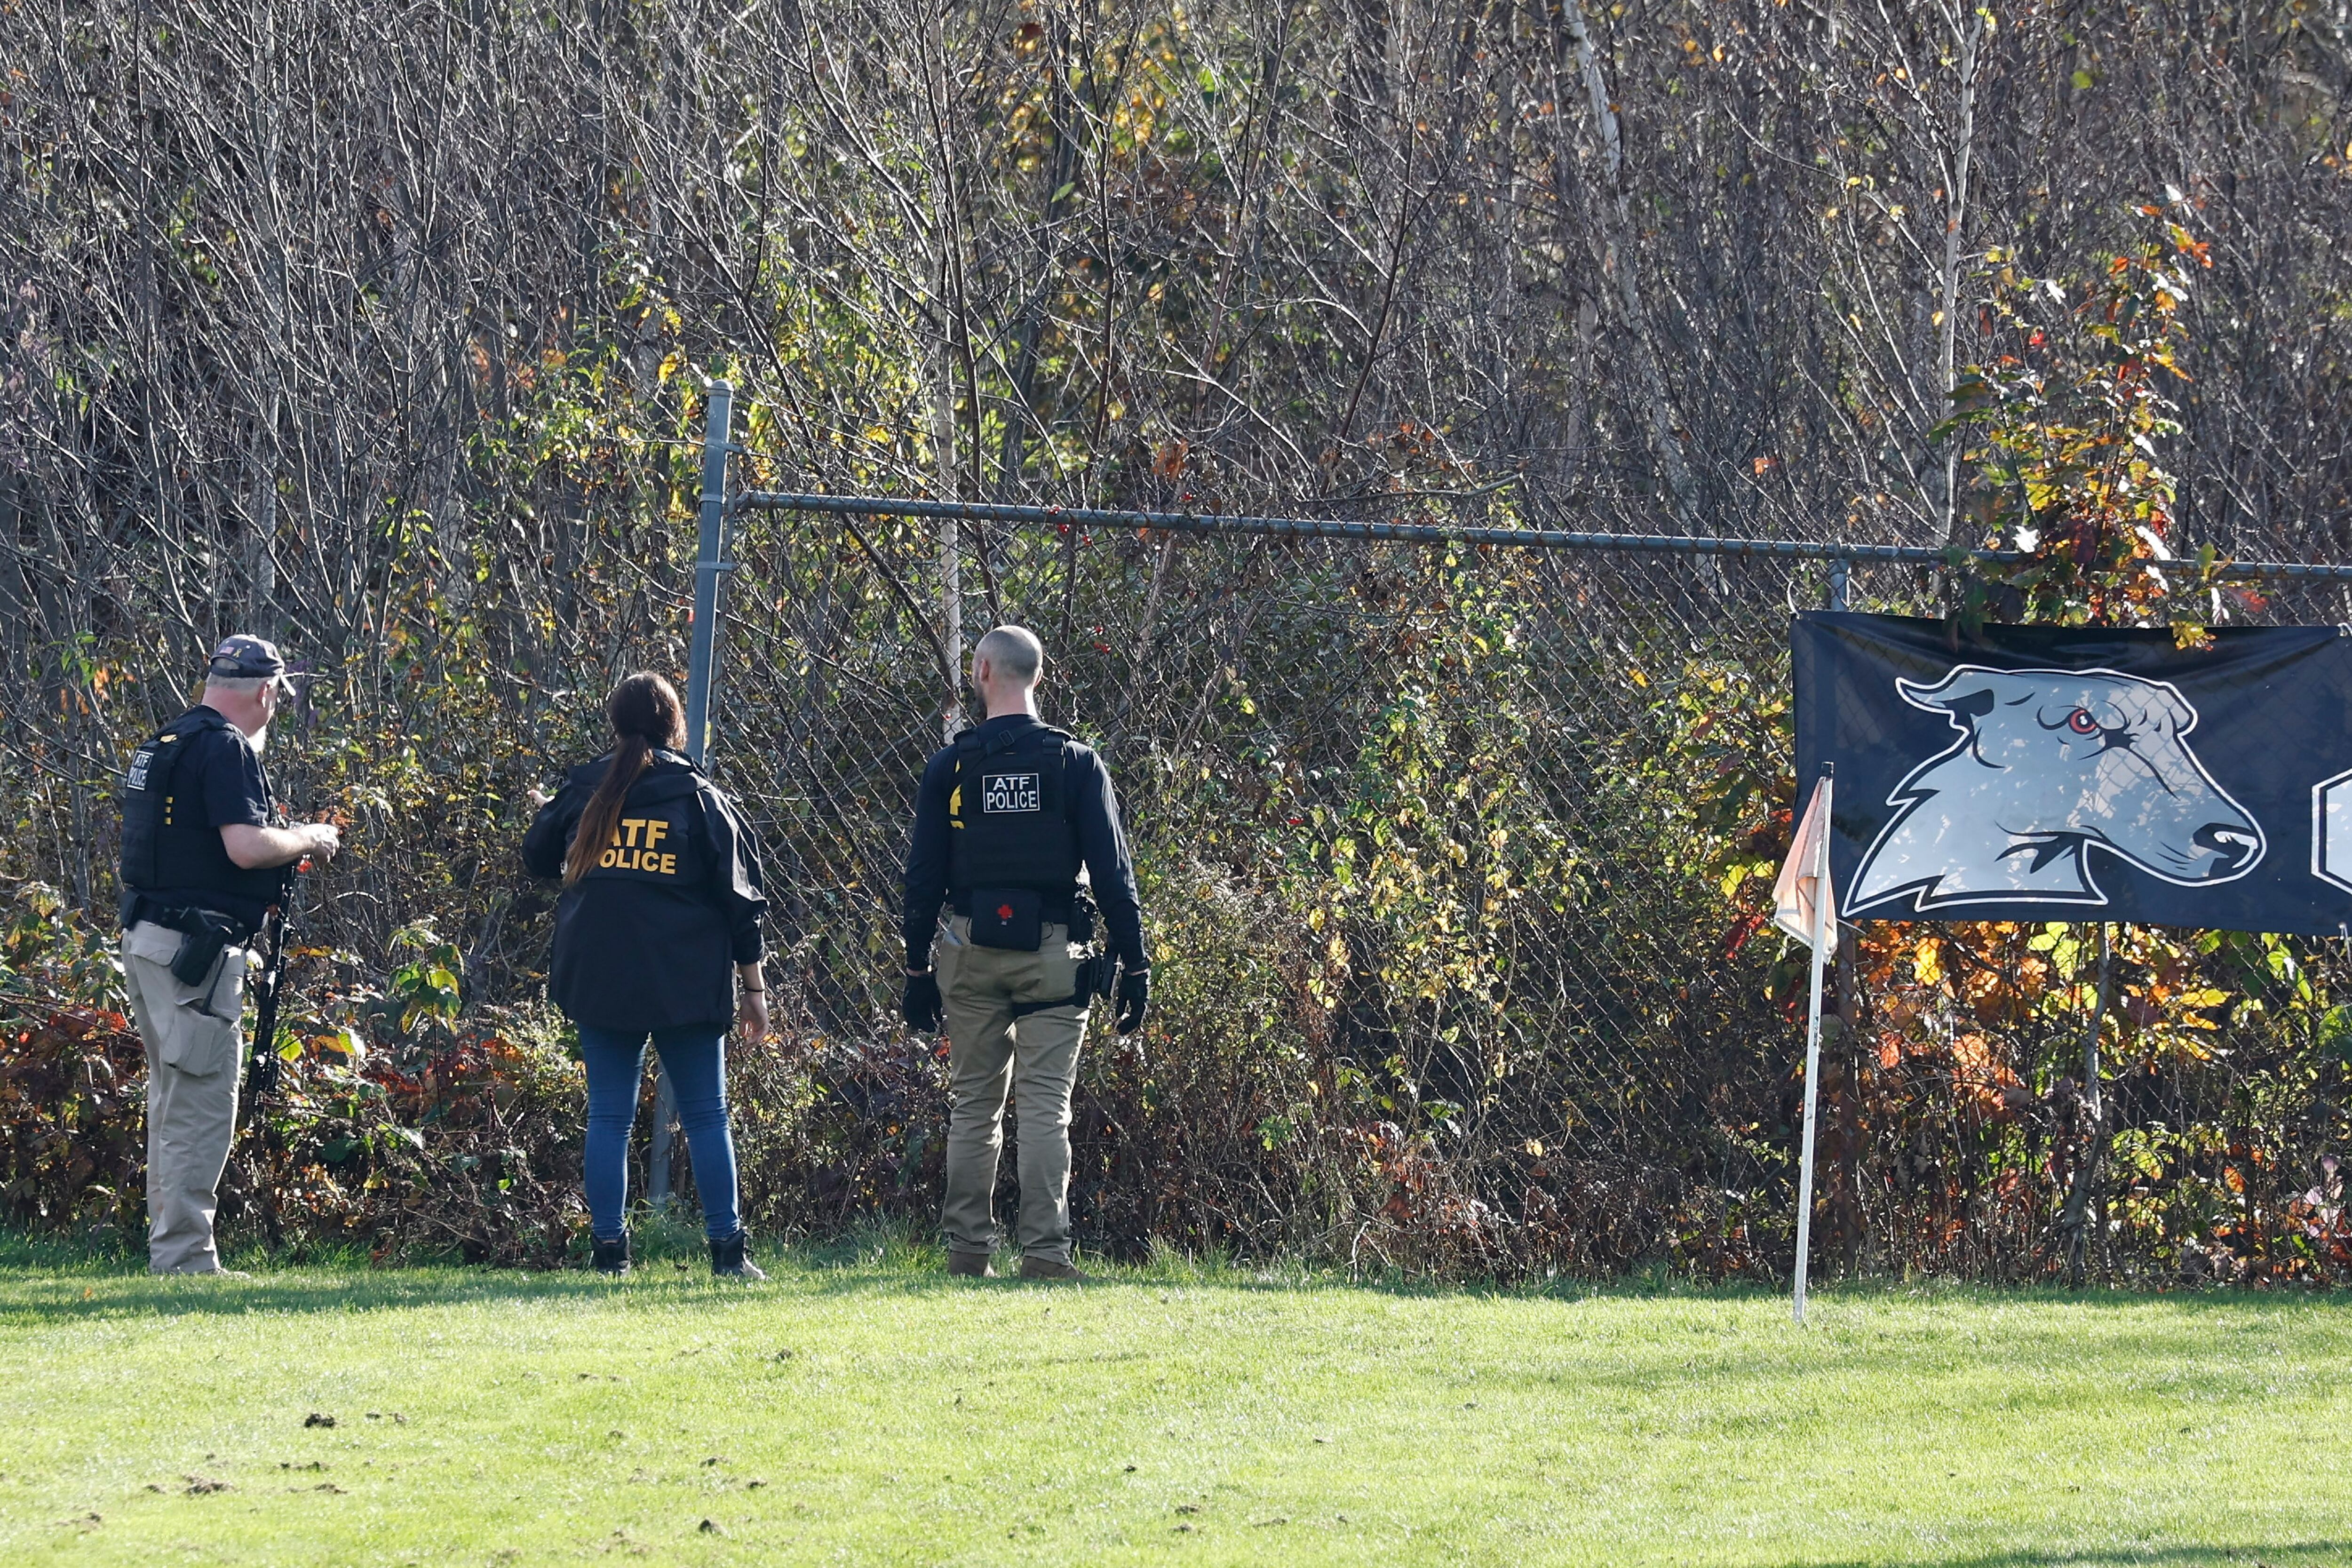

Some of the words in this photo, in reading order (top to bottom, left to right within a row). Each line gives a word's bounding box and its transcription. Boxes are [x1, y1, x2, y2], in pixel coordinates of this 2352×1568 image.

[134, 754, 150, 768] ATF
[993, 776, 1030, 791] ATF
[986, 790, 1037, 810] POLICE
[599, 849, 676, 875] OLICE
